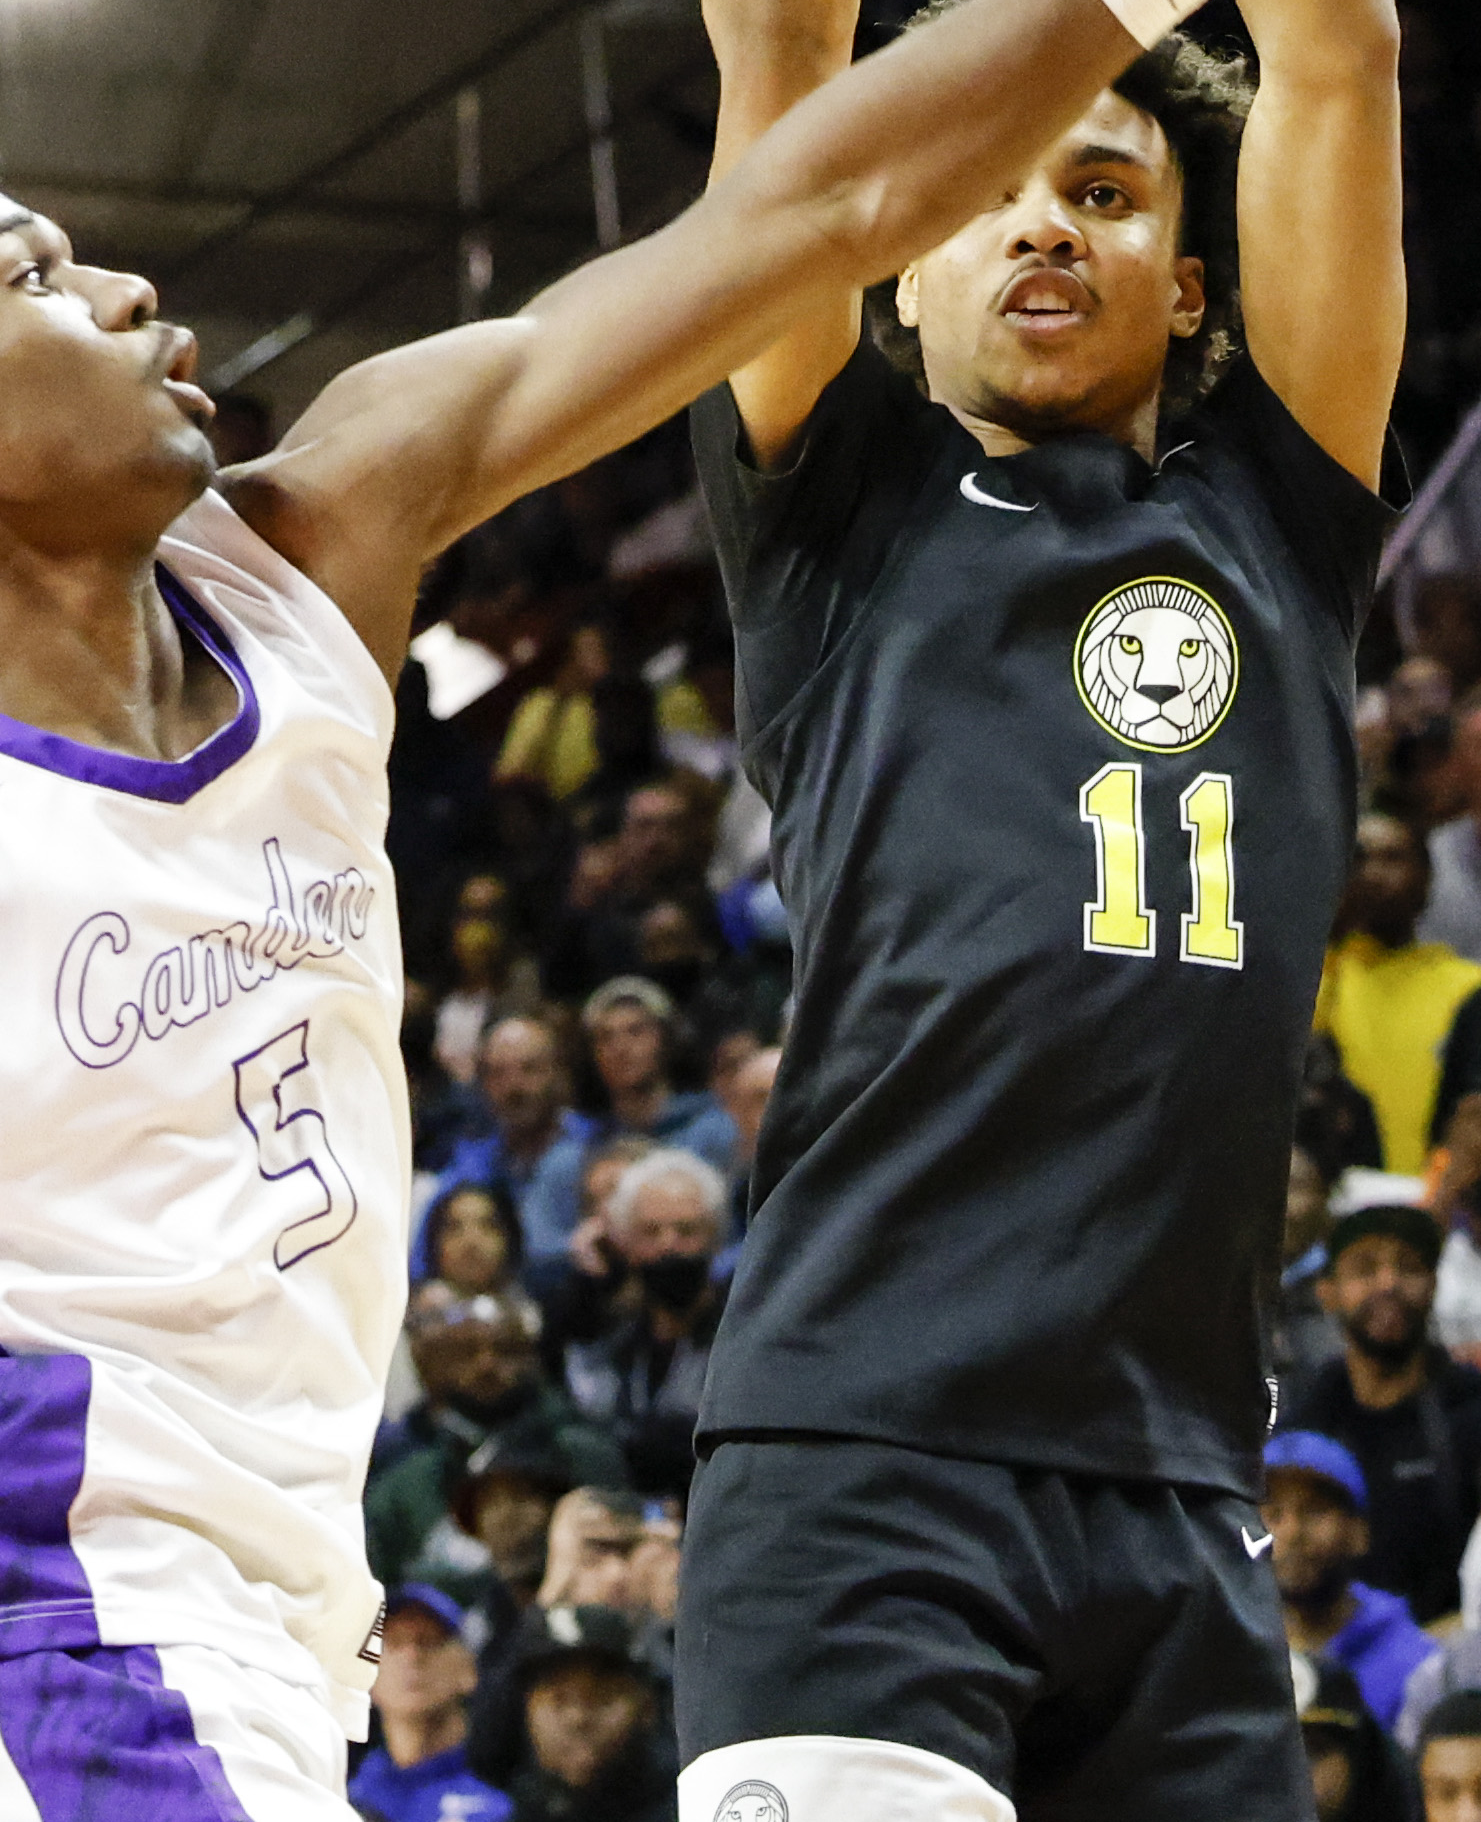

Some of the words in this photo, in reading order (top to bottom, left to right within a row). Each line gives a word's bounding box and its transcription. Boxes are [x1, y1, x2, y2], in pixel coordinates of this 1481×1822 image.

[55, 837, 375, 1070] Camden
[1079, 762, 1245, 970] 11
[231, 1017, 358, 1273] 5
